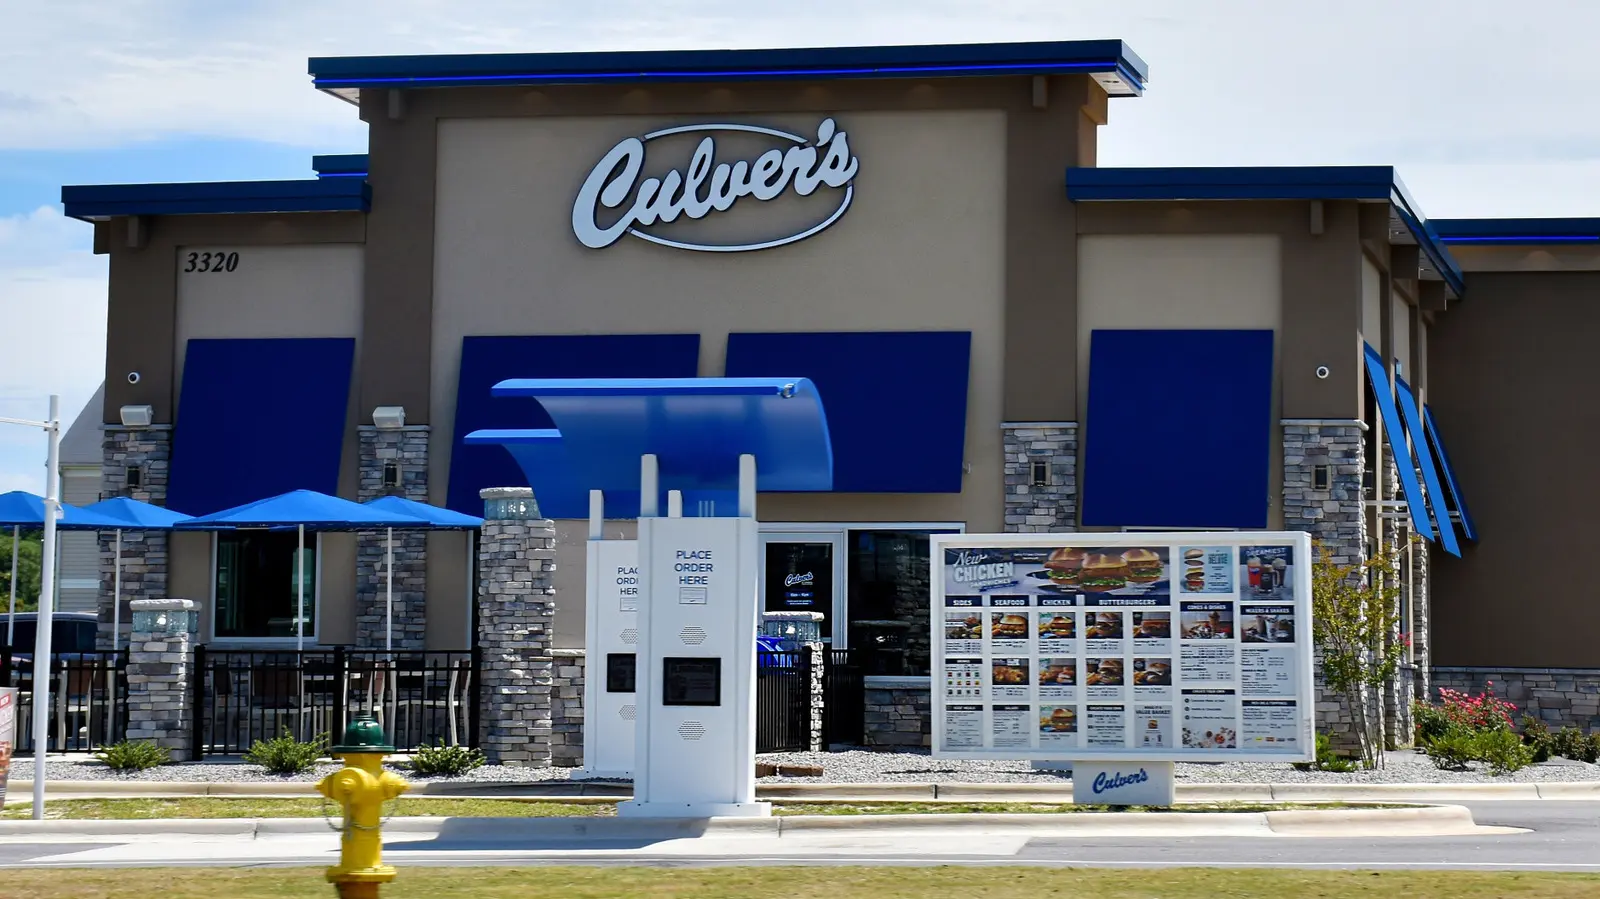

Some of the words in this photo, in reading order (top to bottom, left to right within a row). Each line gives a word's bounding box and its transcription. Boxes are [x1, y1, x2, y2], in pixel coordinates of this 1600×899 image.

[572, 117, 859, 248] Culver's
[184, 252, 239, 272] 3320
[676, 551, 712, 559] PLACE
[953, 552, 987, 567] New
[674, 563, 713, 572] ORDER
[954, 562, 1014, 582] CHICKEN
[679, 576, 708, 584] HERE
[785, 571, 813, 586] Culver's
[1092, 768, 1149, 793] Culver's
